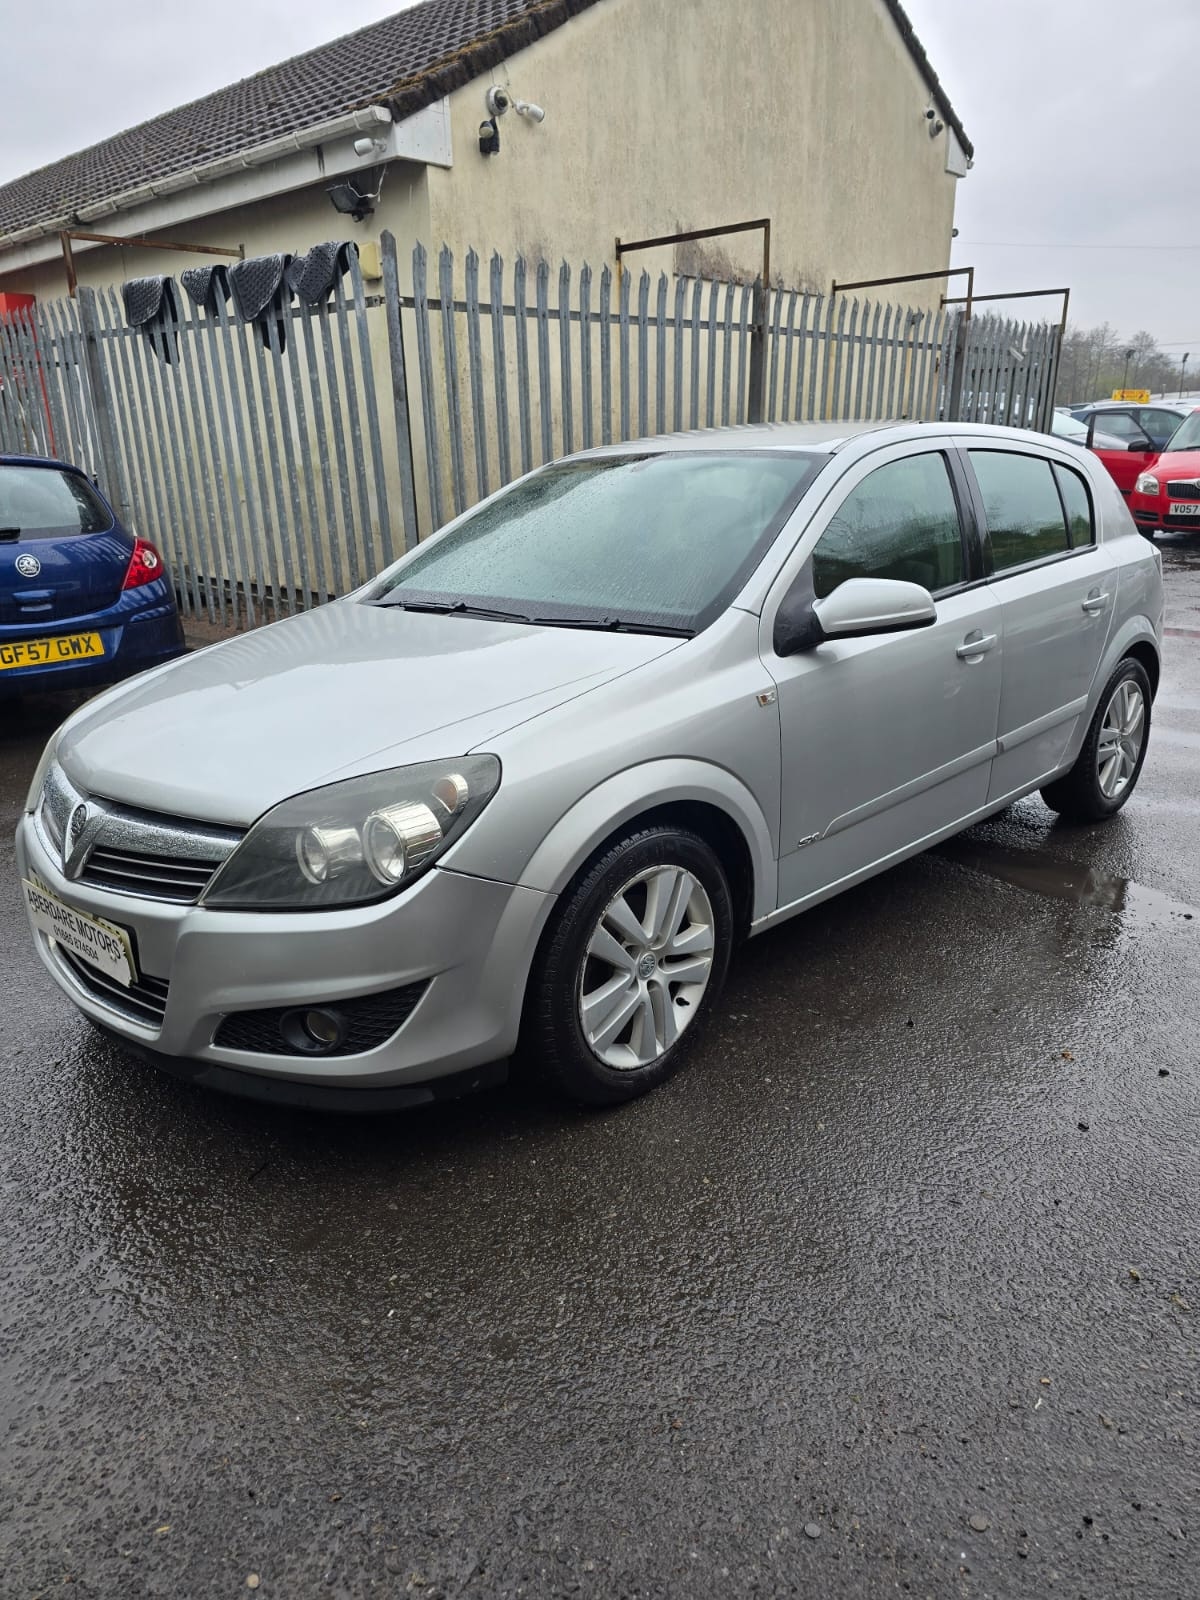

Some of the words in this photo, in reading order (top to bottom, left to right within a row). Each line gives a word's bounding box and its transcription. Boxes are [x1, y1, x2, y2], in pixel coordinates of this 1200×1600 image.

[0, 641, 51, 665] GF57
[56, 635, 95, 656] GWX
[27, 888, 76, 932] ABERDARE
[75, 917, 121, 960] MOTORS
